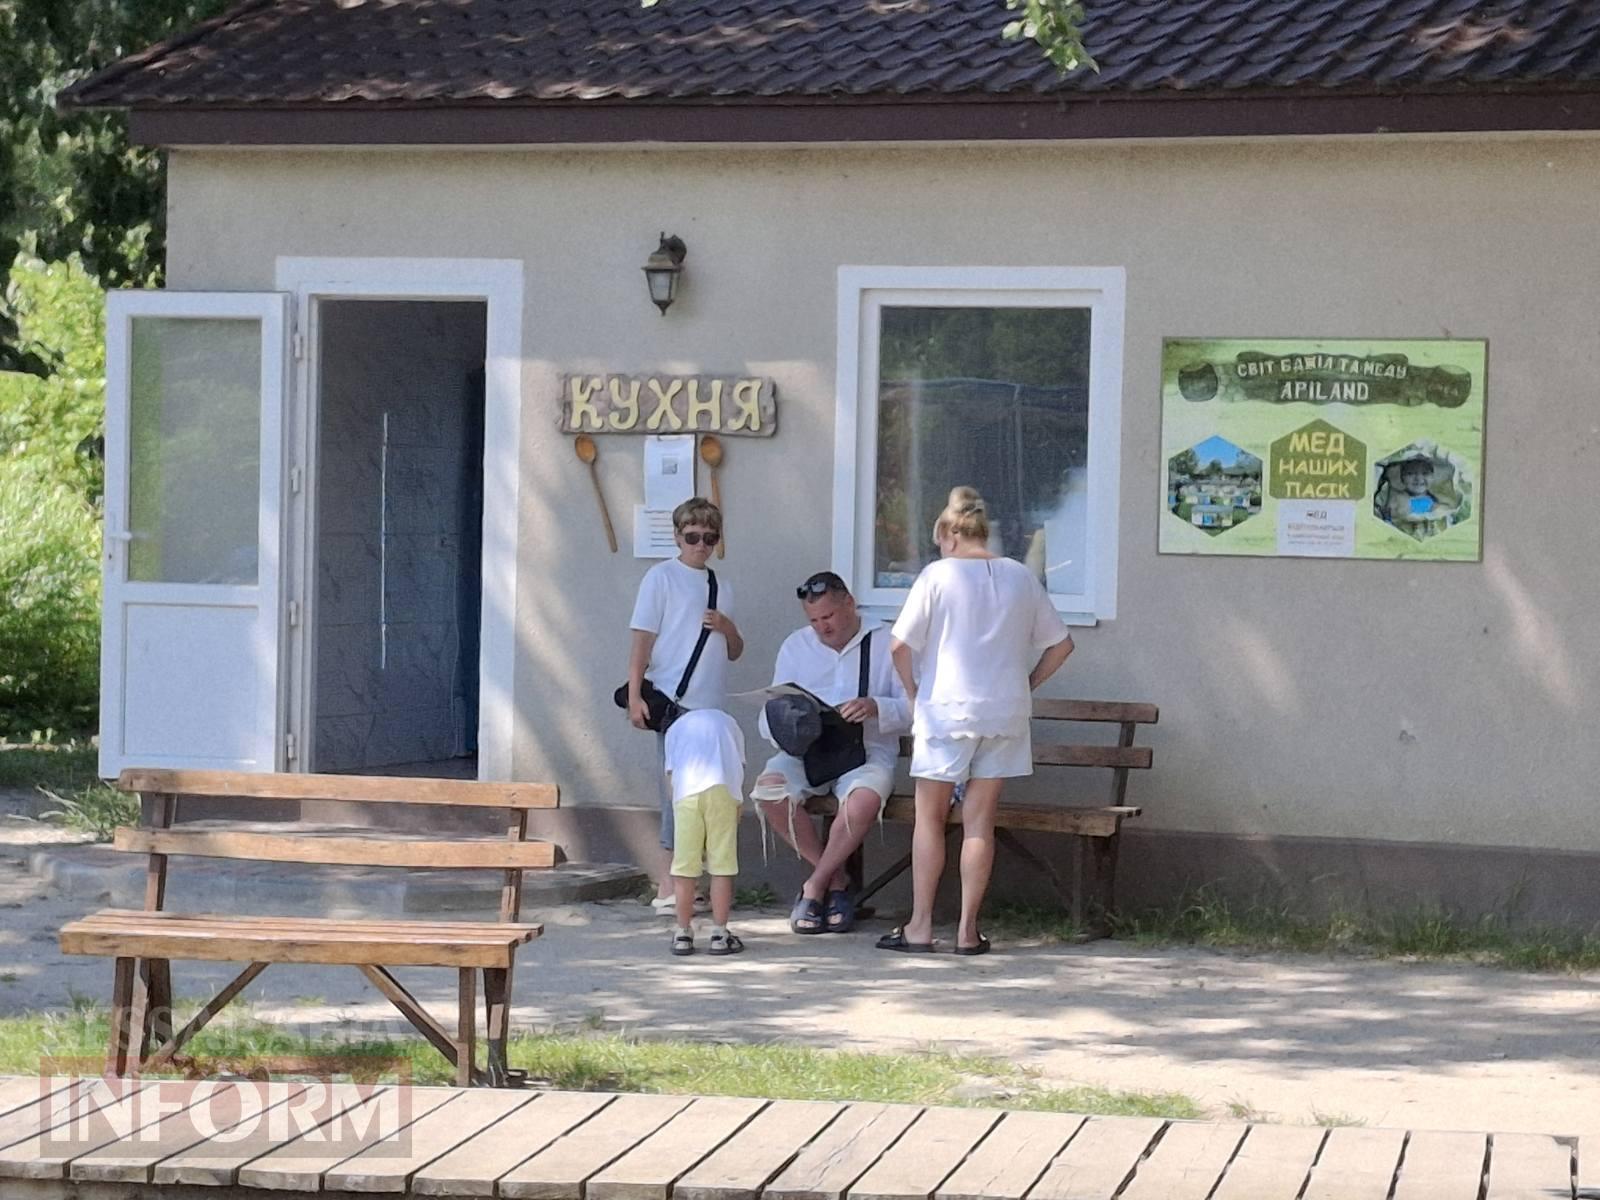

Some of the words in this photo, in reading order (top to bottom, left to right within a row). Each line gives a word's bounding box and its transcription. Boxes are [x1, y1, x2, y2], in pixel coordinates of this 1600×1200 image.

[1237, 360, 1275, 377] СВІТ
[1339, 358, 1359, 374] ТА
[1280, 381, 1369, 400] APILAND
[570, 376, 762, 431] КУХНЯ
[1289, 431, 1345, 457] МЕД
[1279, 458, 1358, 476] НАШИХ
[1285, 481, 1350, 498] ПАСІК
